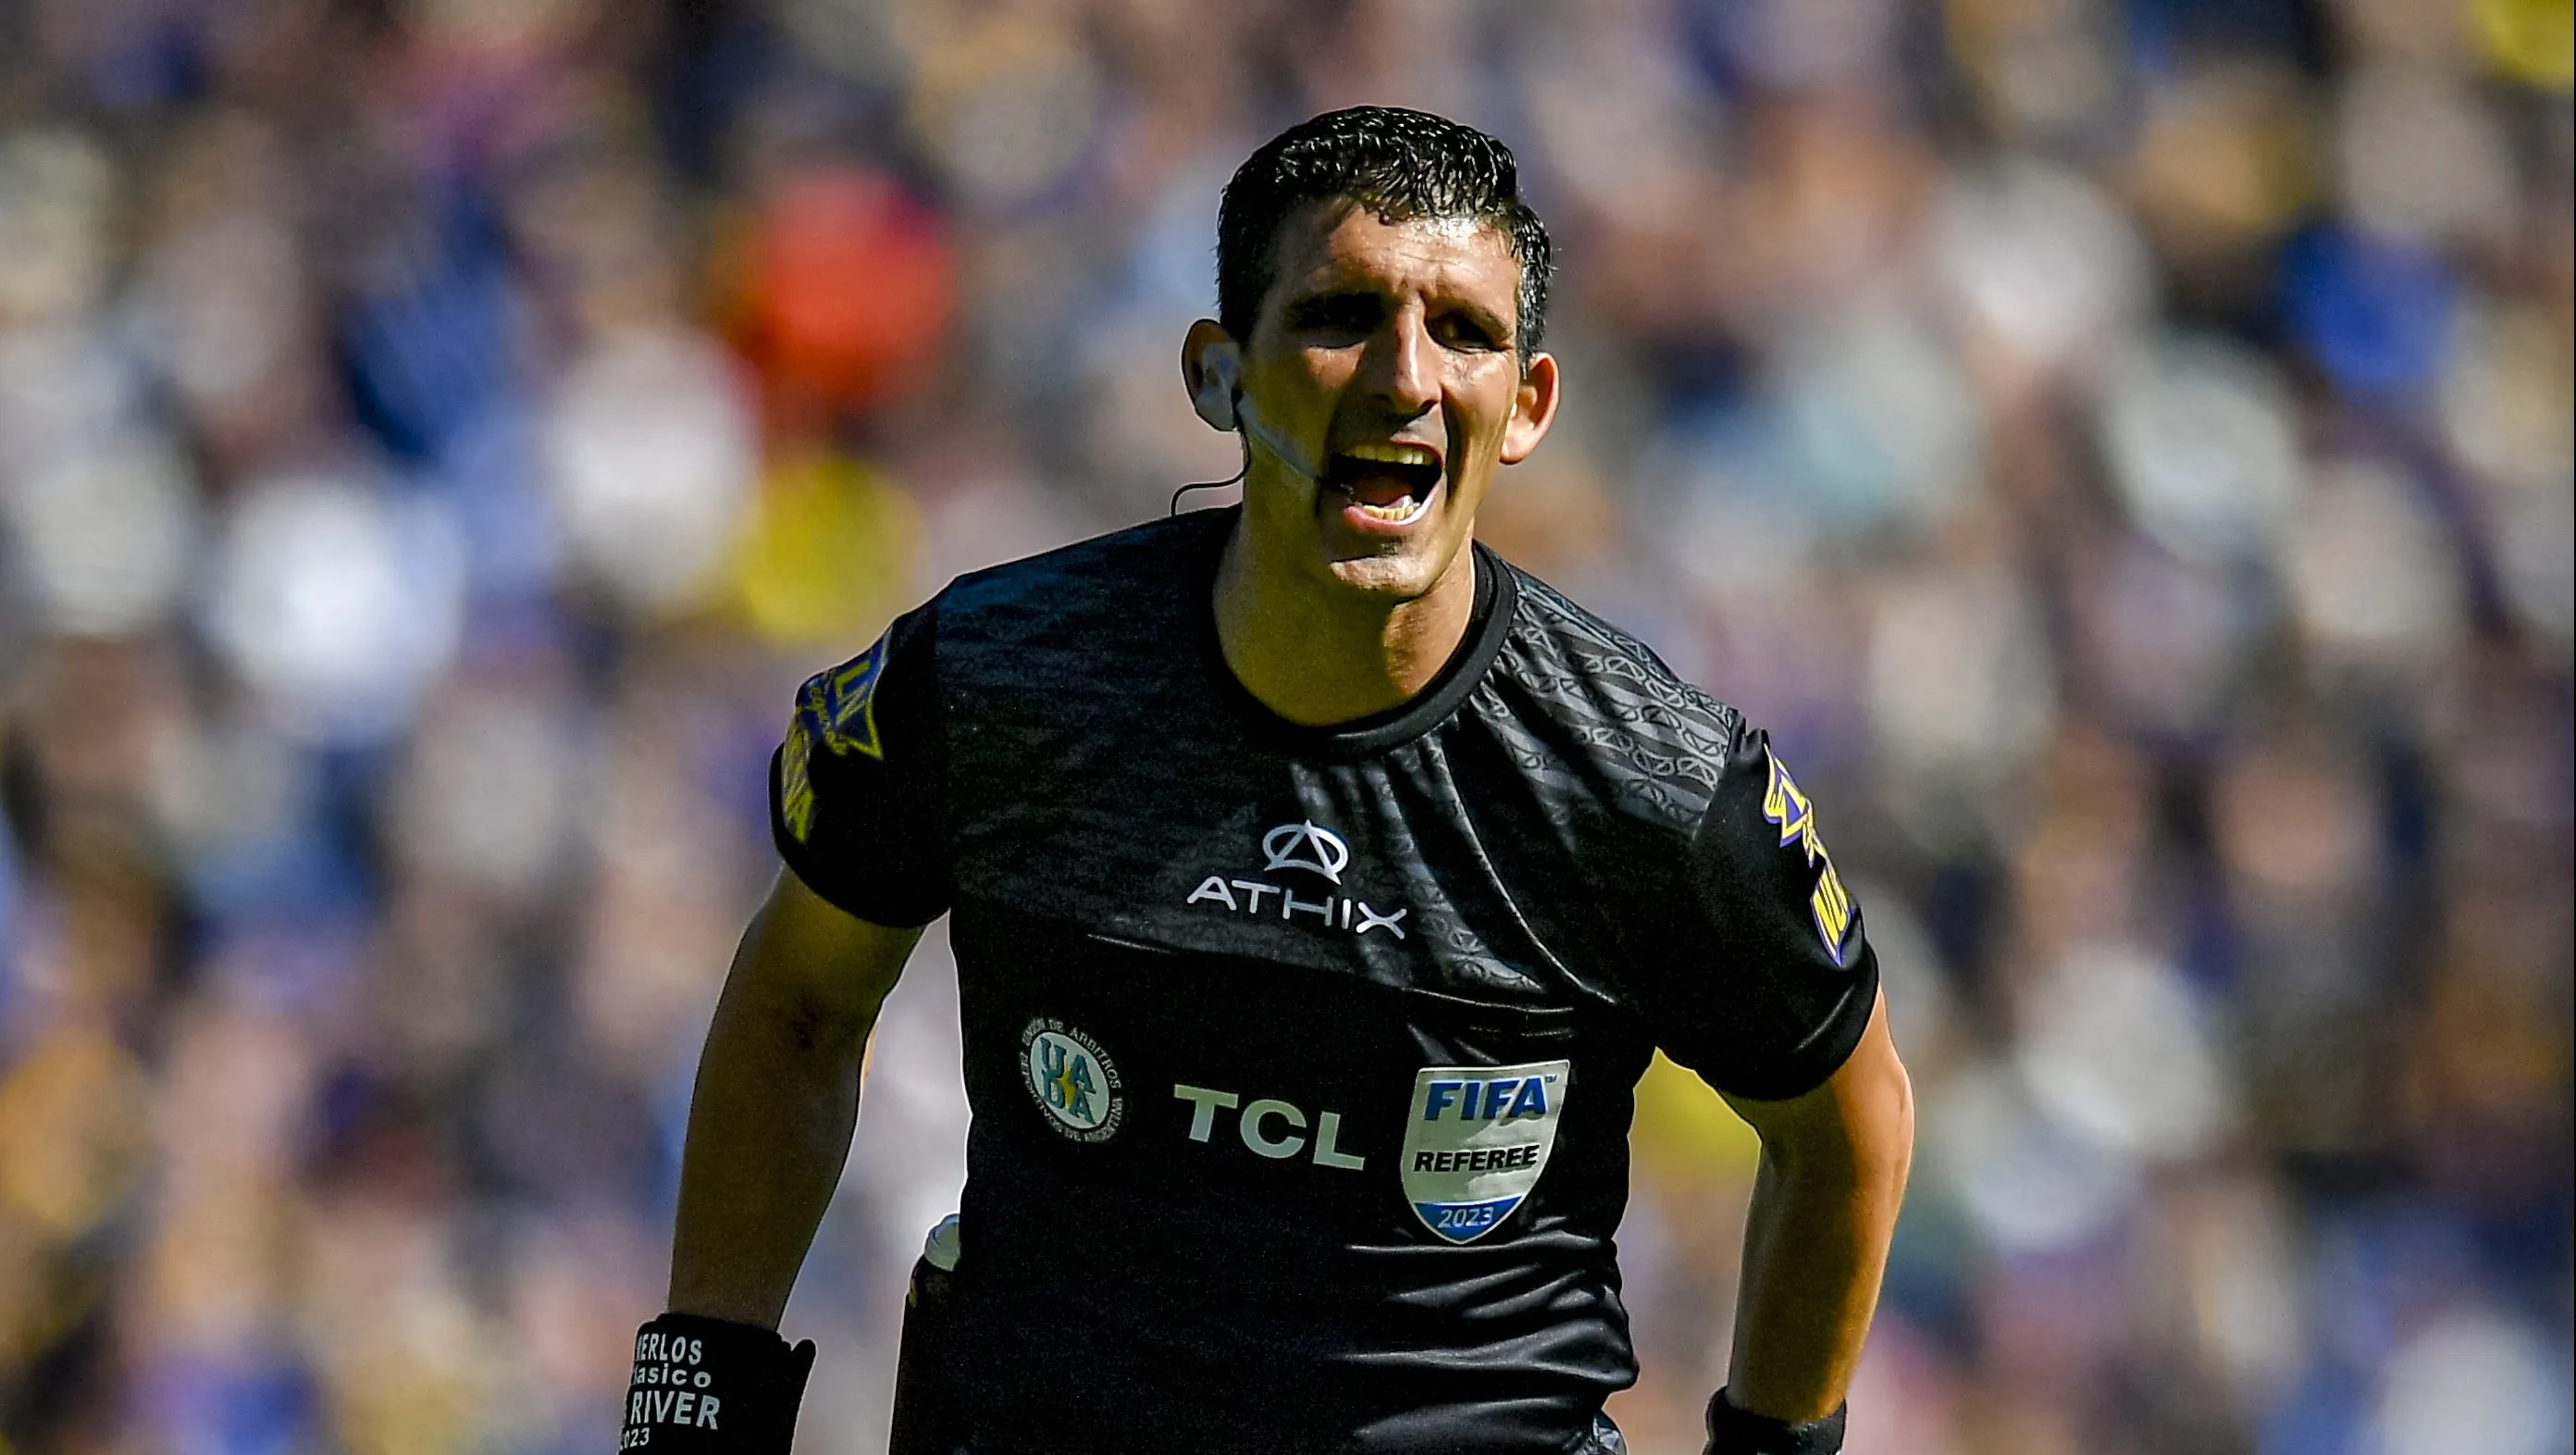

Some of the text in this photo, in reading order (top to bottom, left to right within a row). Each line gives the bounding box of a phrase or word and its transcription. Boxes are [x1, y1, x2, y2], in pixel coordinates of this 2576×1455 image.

[1186, 875, 1408, 940] ATHIX
[1069, 1026, 1121, 1089] ARBITROS
[1173, 1083, 1366, 1171] TCL
[1413, 1143, 1541, 1173] REFEREE
[1436, 1206, 1495, 1229] 2023
[629, 1390, 722, 1431] RIVER
[619, 1427, 650, 1451] 023
